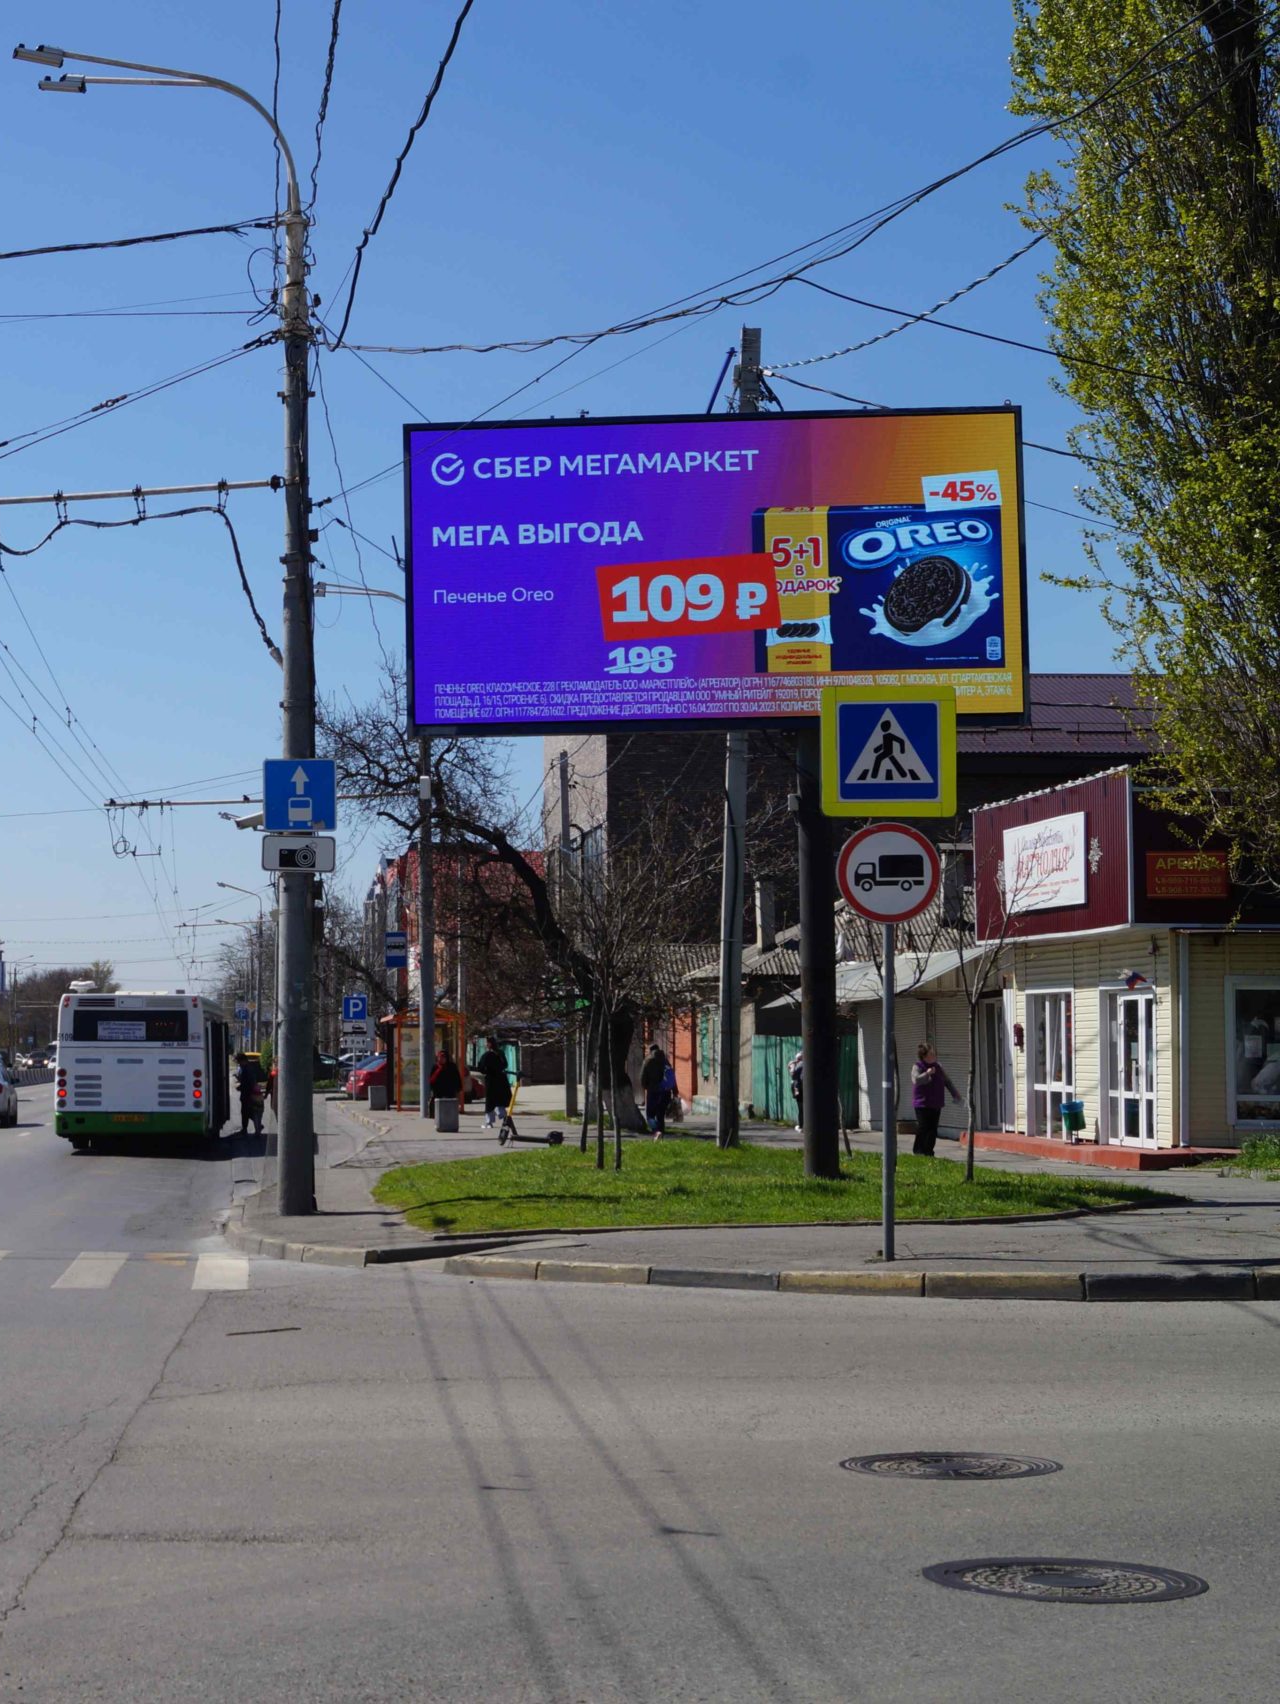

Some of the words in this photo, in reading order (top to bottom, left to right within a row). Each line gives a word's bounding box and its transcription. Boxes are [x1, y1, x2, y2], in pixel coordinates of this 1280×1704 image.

[473, 455, 552, 479] СБЕР
[559, 449, 760, 477] МЕГАМАРКЕТ
[929, 479, 997, 503] -45%
[432, 524, 510, 547] МЕГА
[518, 521, 644, 546] ВЫГОДА
[848, 519, 988, 562] OREO
[771, 537, 822, 568] 5+1
[795, 565, 804, 576] В
[433, 588, 507, 604] Печенье
[512, 587, 554, 602] Oreo
[775, 577, 842, 595] ОДАРОК
[612, 574, 725, 623] 109
[606, 645, 675, 674] 198
[434, 683, 466, 694] ПЕЧЕНЬЕ
[543, 681, 555, 692] 228
[623, 679, 638, 690] ООО
[816, 675, 833, 686] ИНН
[503, 694, 539, 705] СТРОЕНИЕ
[549, 693, 579, 705] СКИДКА
[579, 692, 647, 704] ПРЕДОСТАВЛЯЕТСЯ
[648, 690, 695, 703] ПРОДАВЦОМ
[695, 690, 711, 701] ООО
[434, 707, 480, 720] ПОМЕЩЕНИЕ
[495, 706, 514, 717] ОГРН
[567, 705, 621, 717] ПРЕДЛОЖЕНИЕ
[621, 703, 681, 716] ДЕЙСТВИТЕЛЬНО
[740, 701, 775, 713] 30.04.2023
[350, 999, 363, 1018] P
